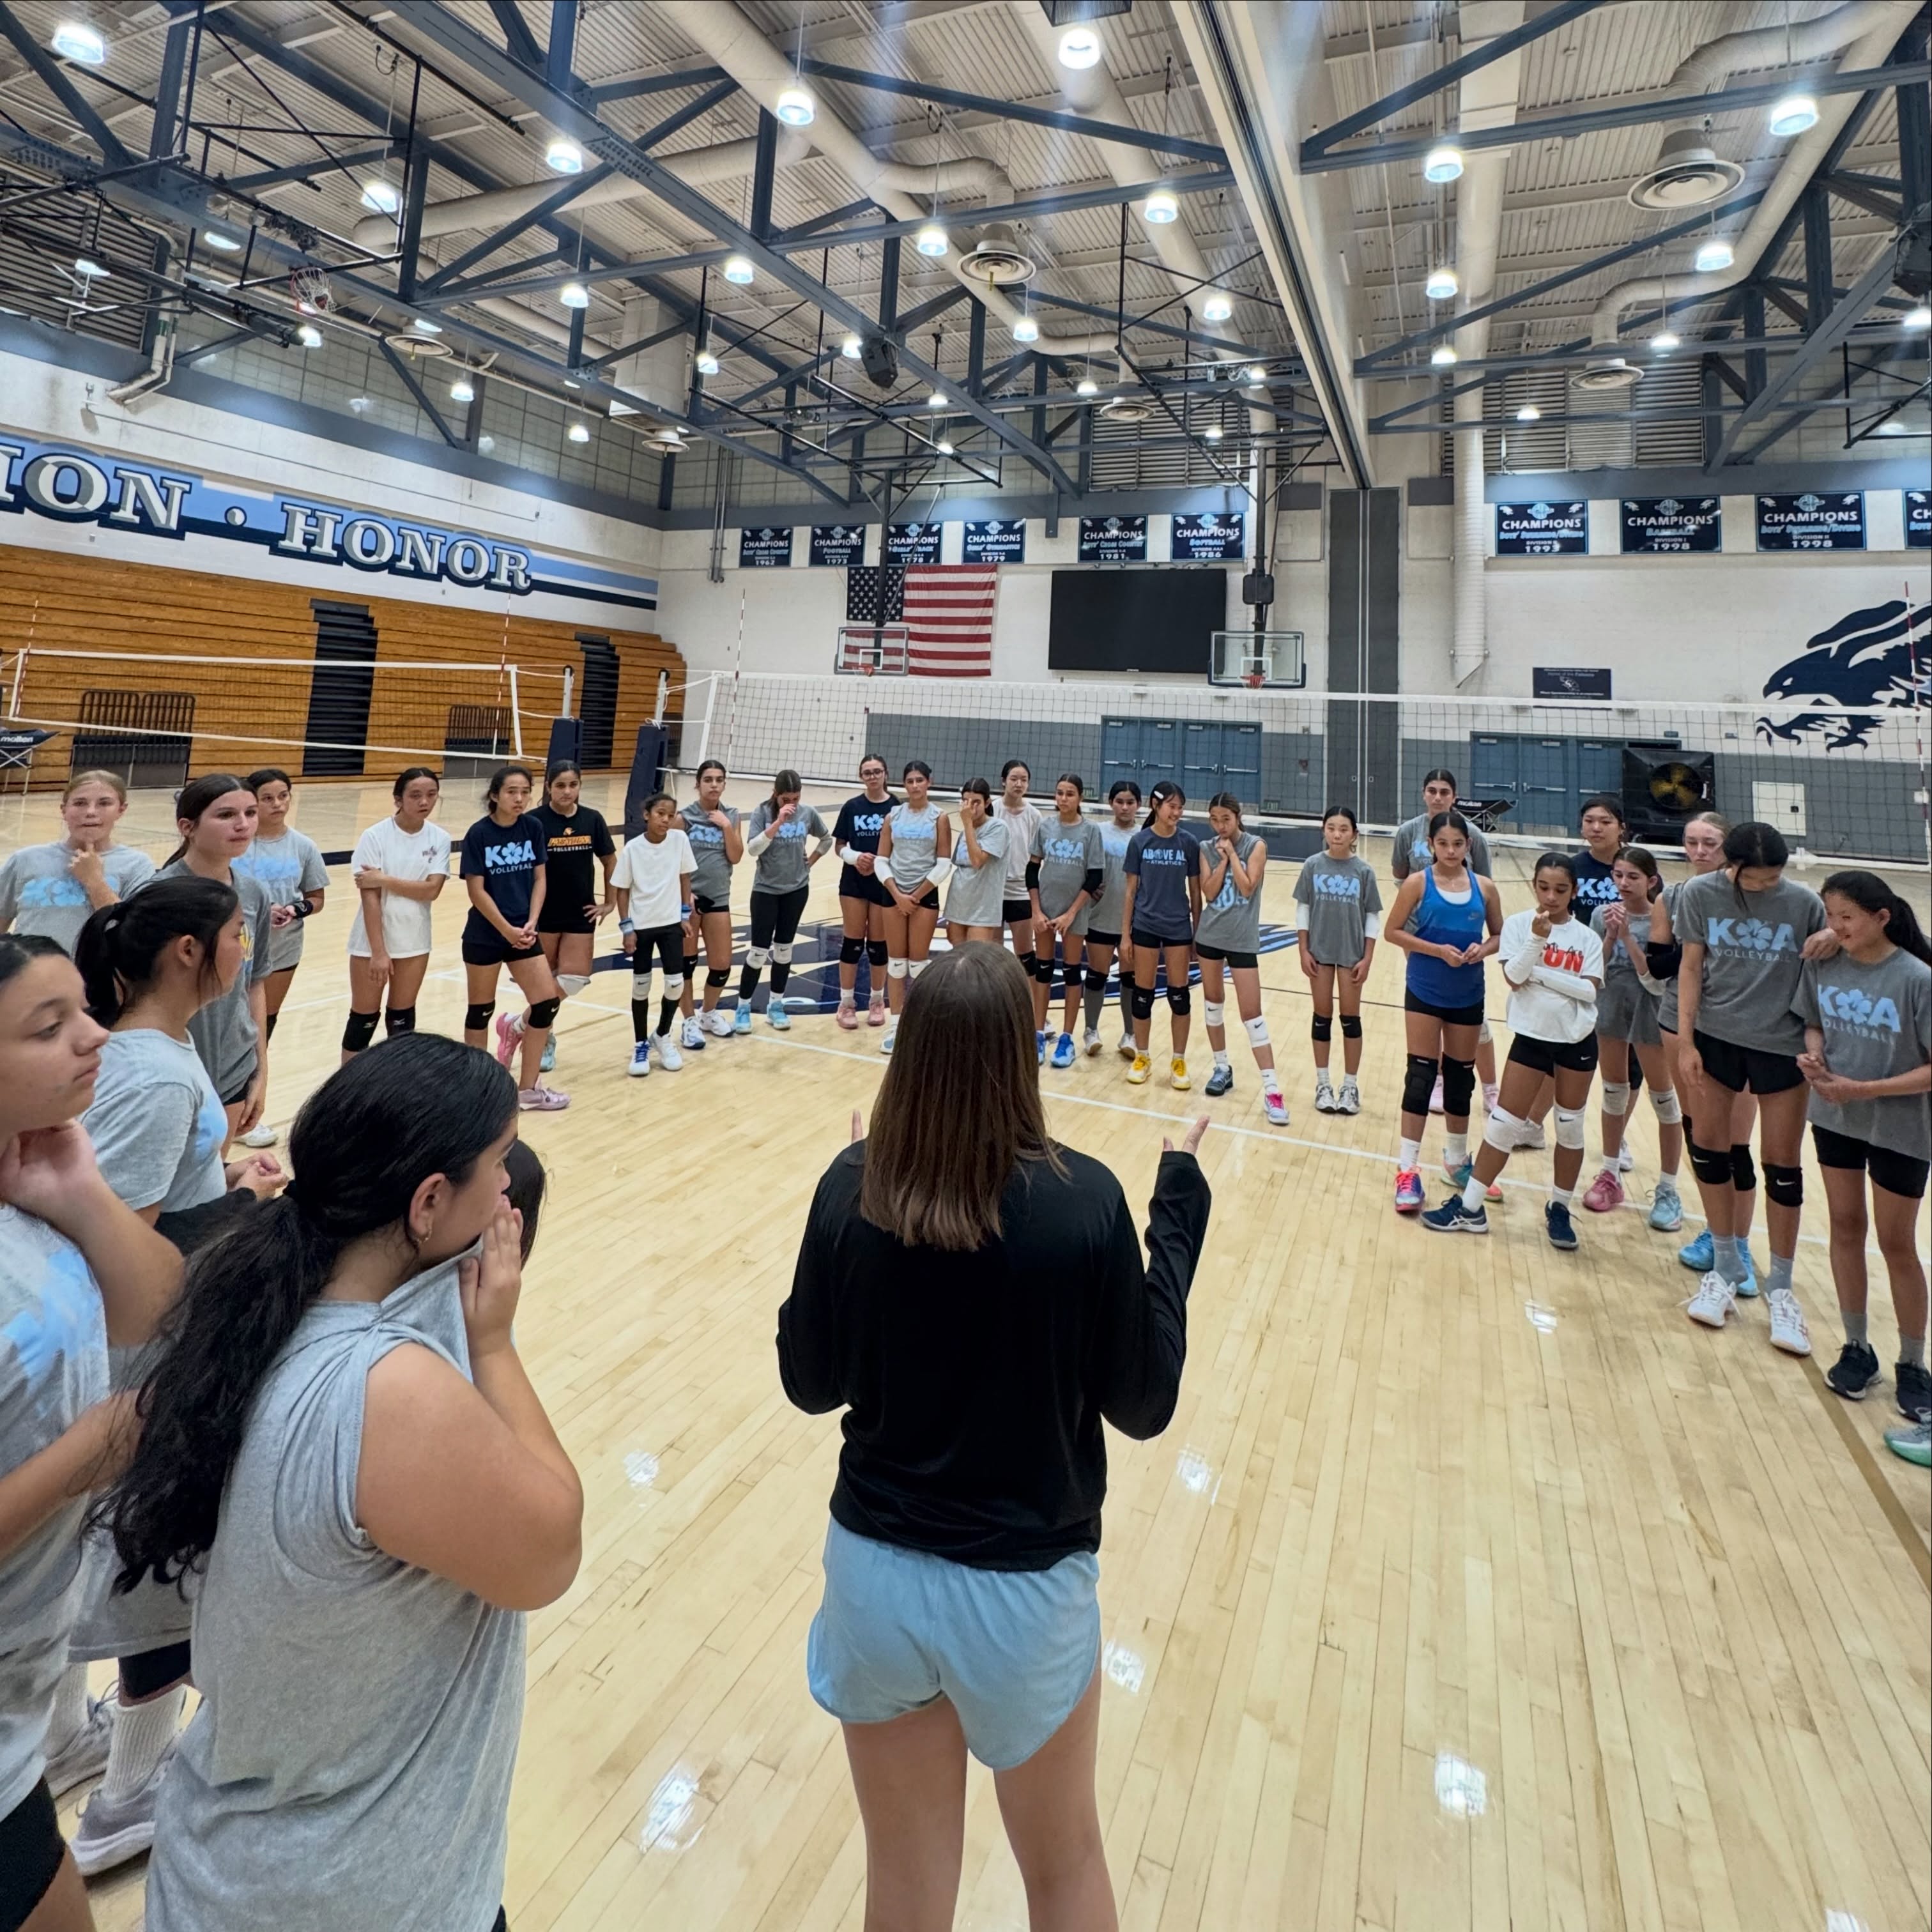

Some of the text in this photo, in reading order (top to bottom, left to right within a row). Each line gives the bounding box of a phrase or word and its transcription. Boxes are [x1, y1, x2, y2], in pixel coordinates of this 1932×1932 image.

[1627, 515, 1713, 526] CHAMPIONS
[1764, 511, 1858, 523] CHAMPIONS
[1502, 519, 1581, 530] CHAMPIONS
[967, 534, 1021, 542] CHAMPIONS
[1084, 531, 1143, 539] CHAMPIONS
[1176, 528, 1239, 538] CHAMPIONS
[277, 501, 532, 591] HONOR
[744, 540, 788, 548] CHAMPIONS
[1565, 946, 1583, 955] Are
